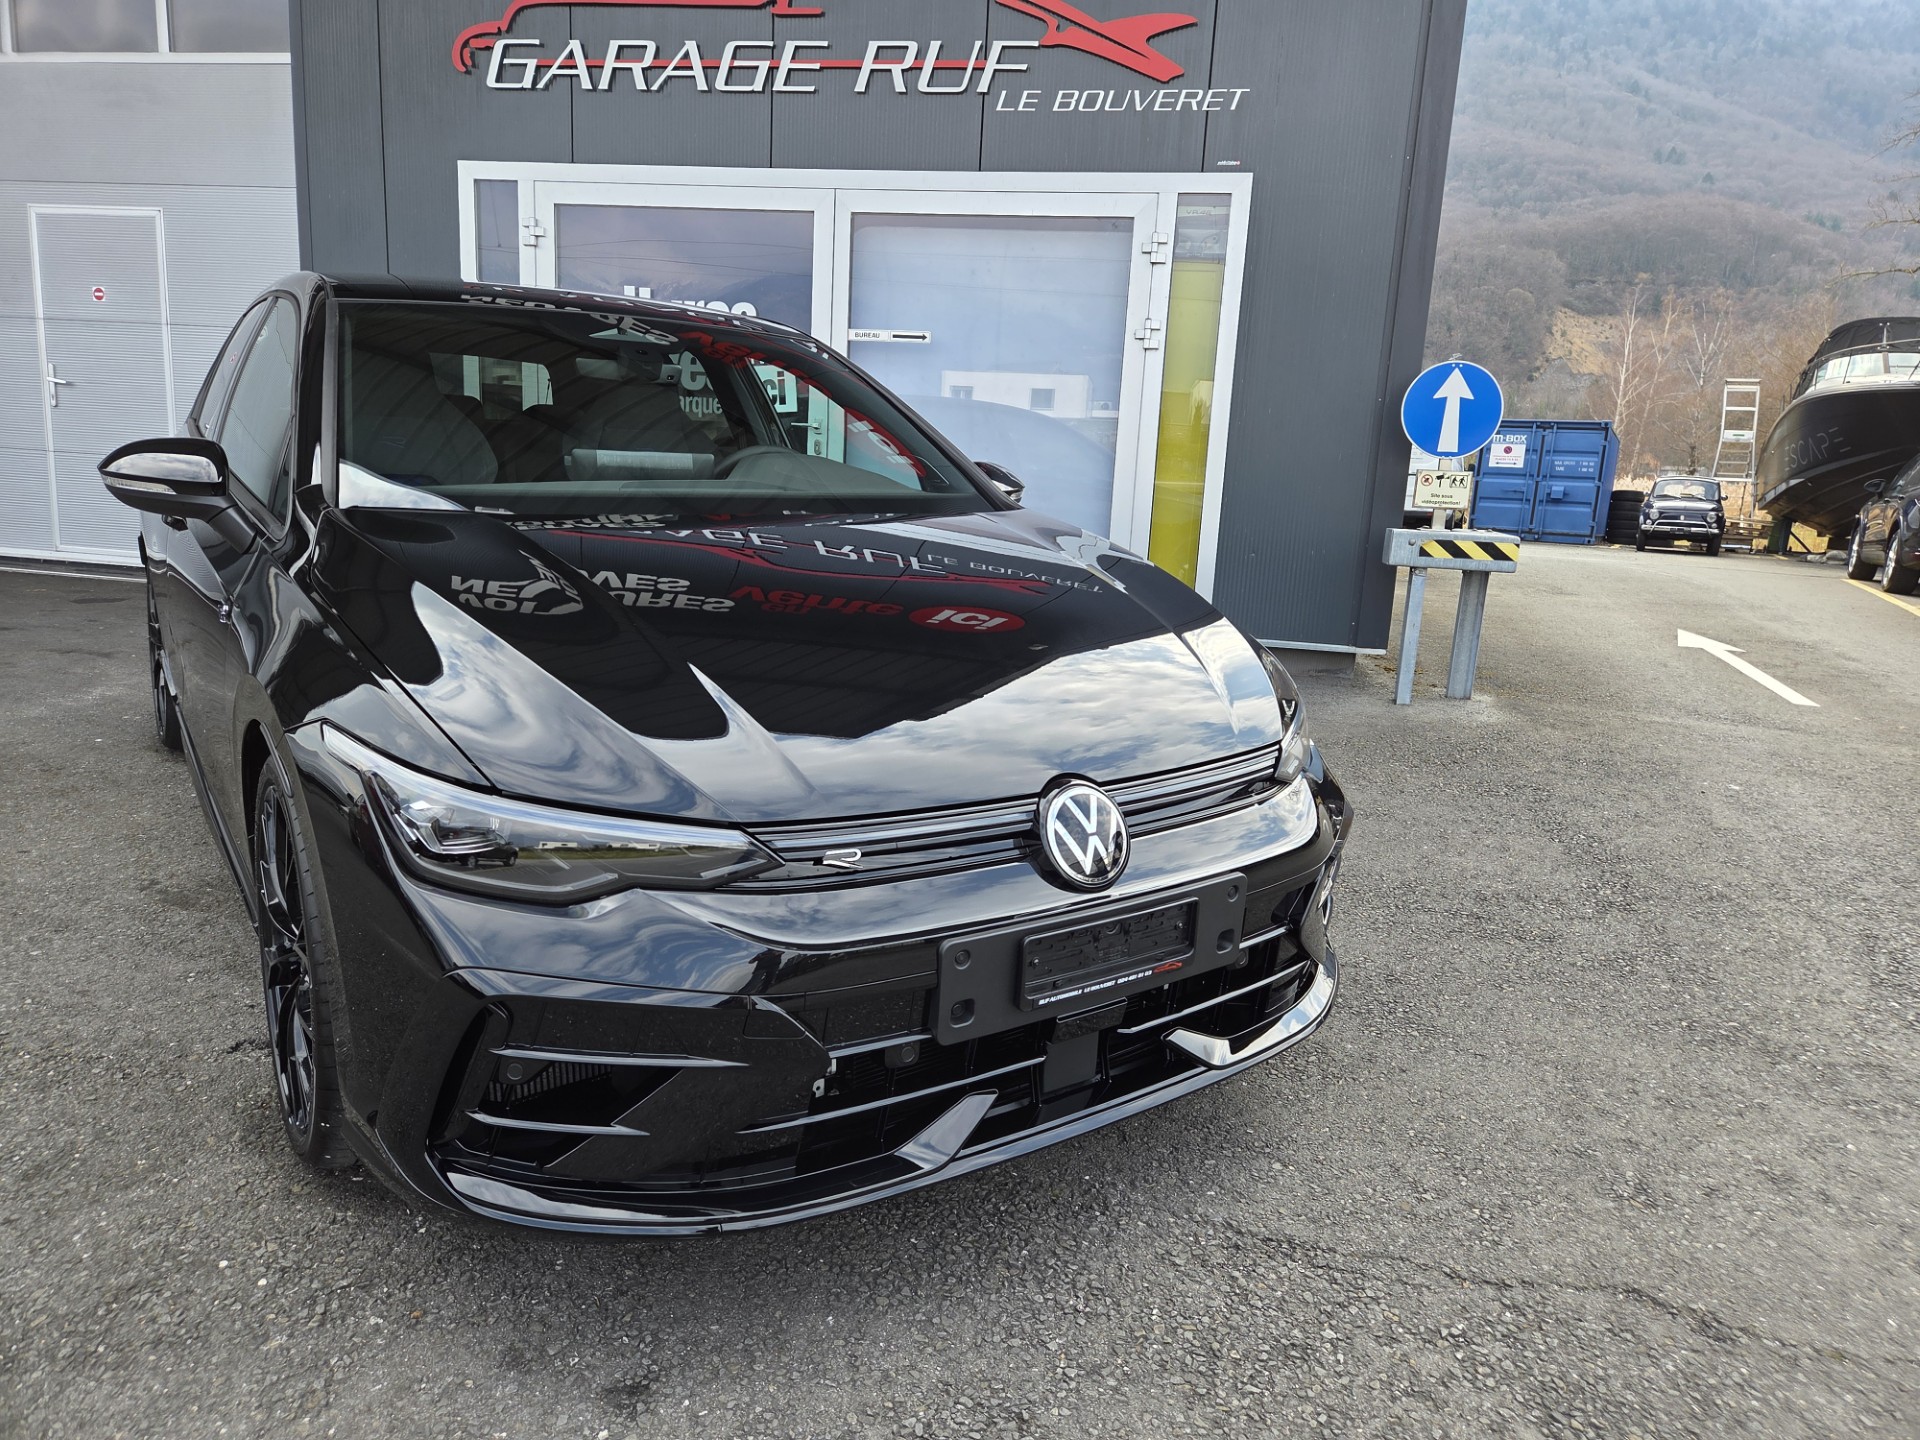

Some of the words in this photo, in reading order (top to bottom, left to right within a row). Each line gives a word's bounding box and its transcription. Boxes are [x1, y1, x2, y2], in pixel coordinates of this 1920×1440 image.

[486, 37, 829, 93] GARAGE
[852, 38, 1039, 94] RUF
[995, 88, 1042, 111] LE
[1052, 88, 1250, 112] BOUVERET
[822, 848, 864, 870] R
